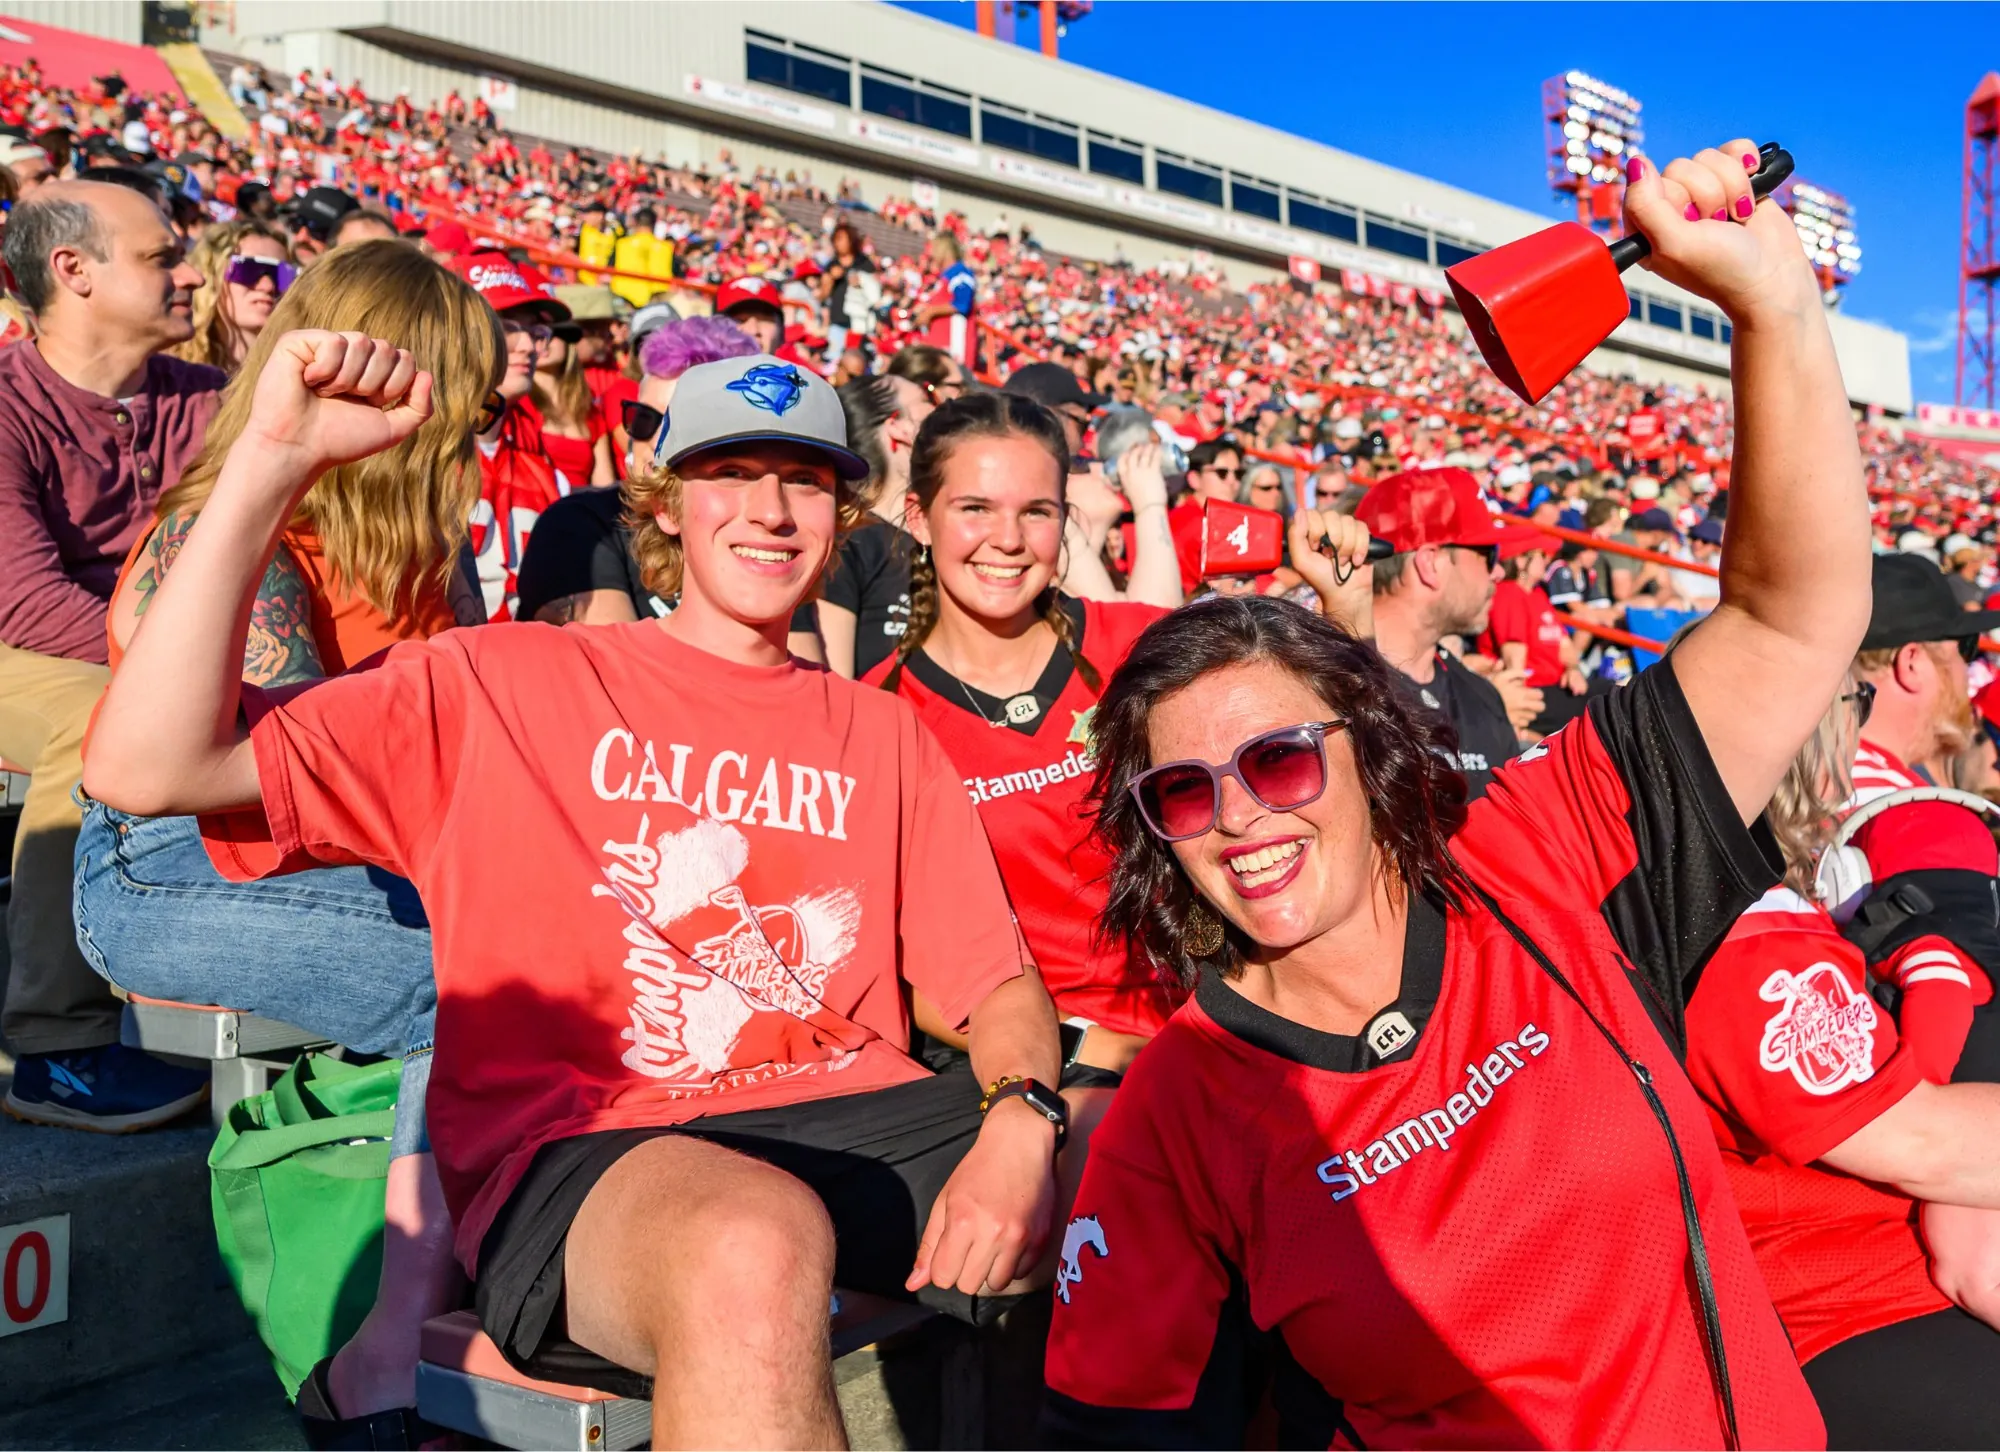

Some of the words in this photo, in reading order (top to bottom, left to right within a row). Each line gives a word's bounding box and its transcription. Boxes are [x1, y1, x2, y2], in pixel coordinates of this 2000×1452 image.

[590, 727, 857, 841] CALGARY
[962, 750, 1097, 805] Stampede
[1376, 1024, 1406, 1050] CFL
[1767, 1000, 1874, 1064] STAMPEDERS
[1315, 1022, 1550, 1202] Stampeders
[4, 1230, 51, 1323] 0
